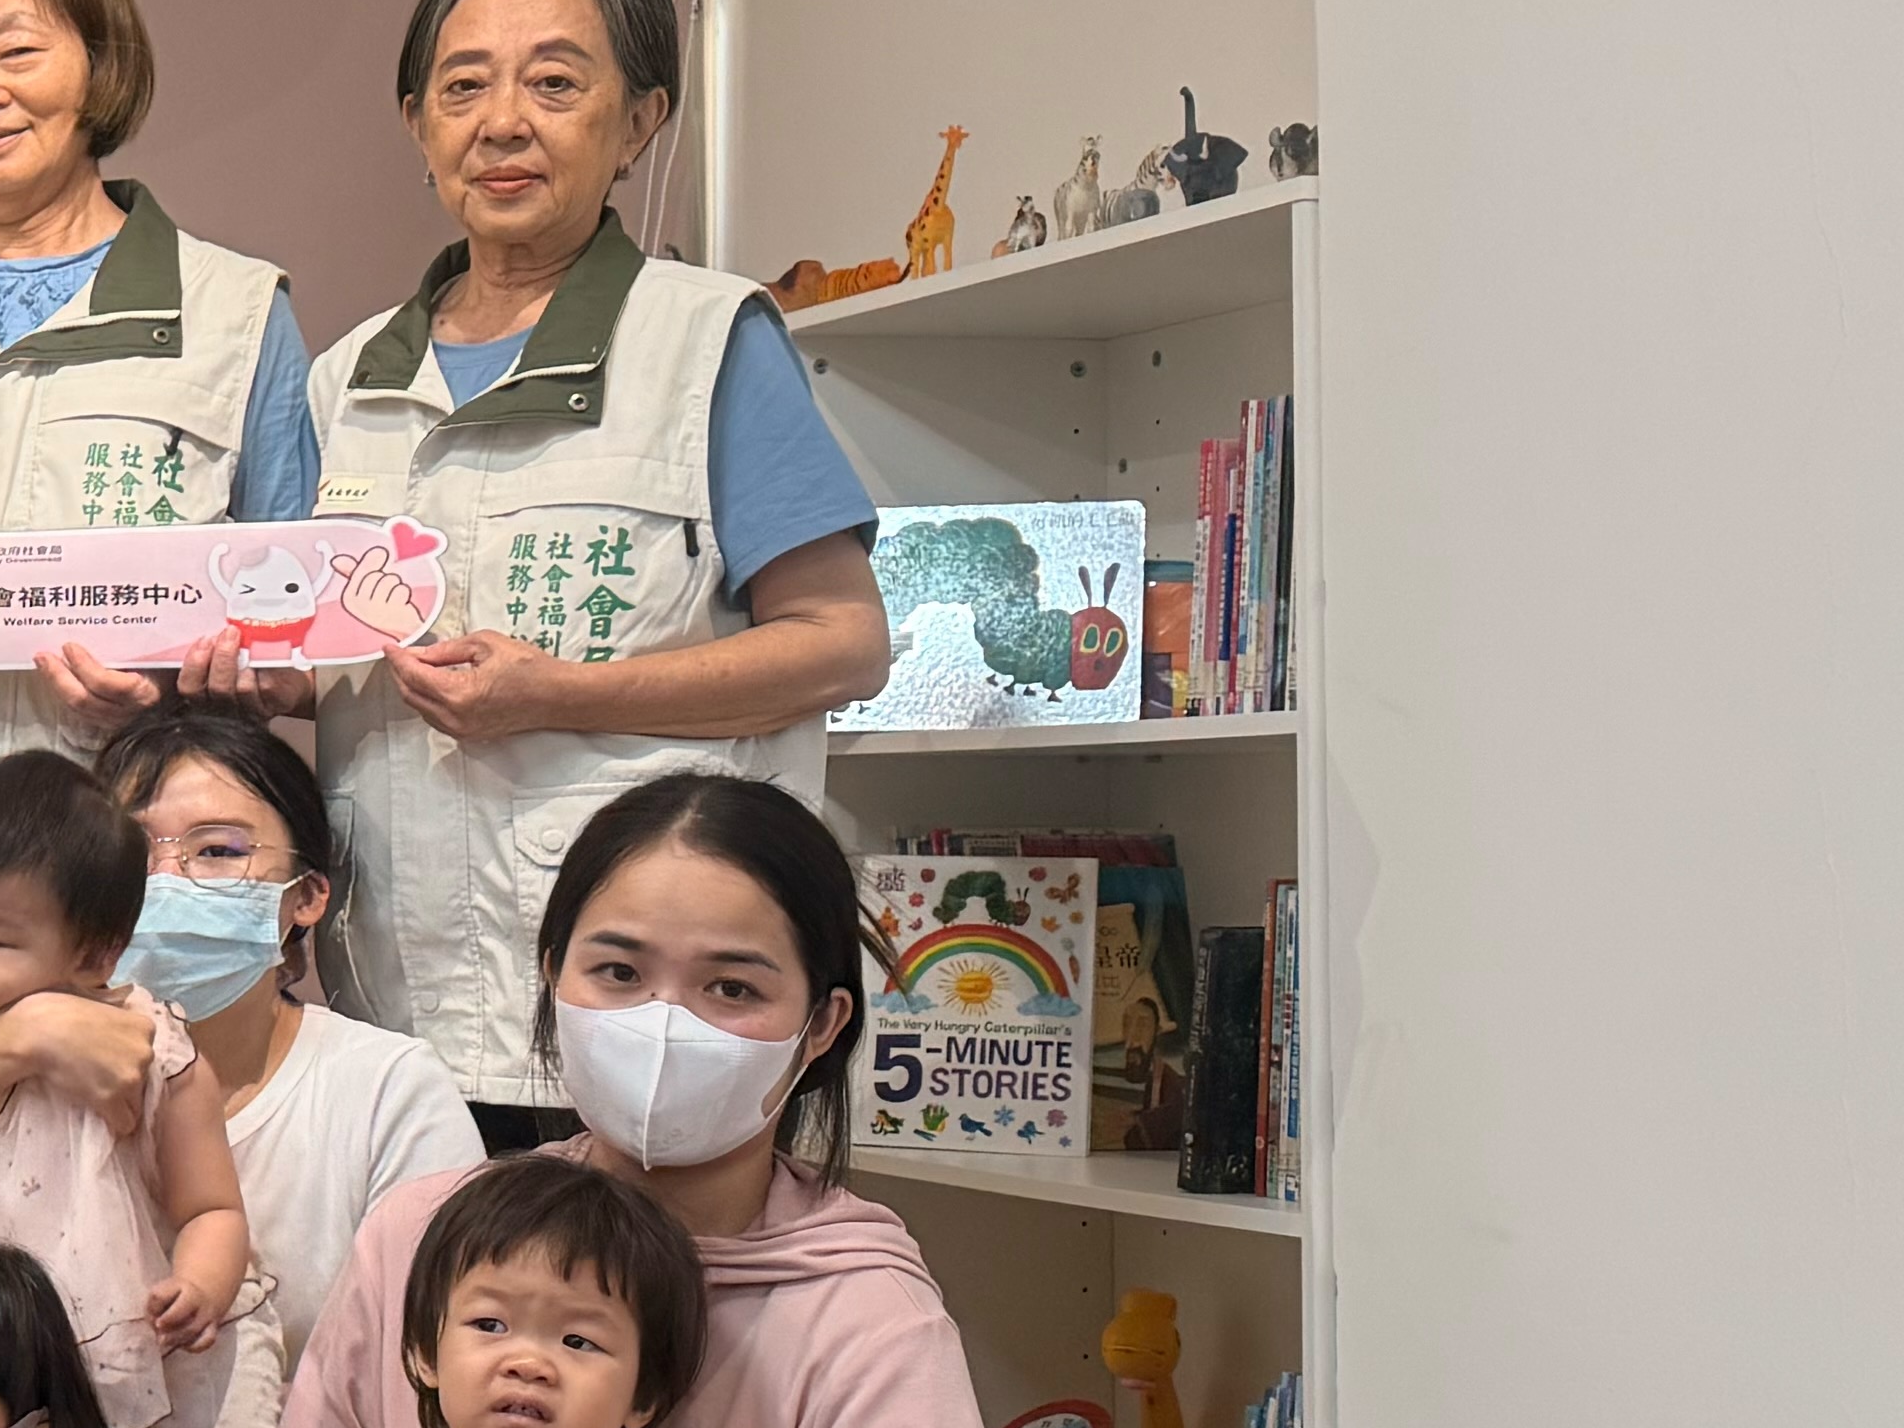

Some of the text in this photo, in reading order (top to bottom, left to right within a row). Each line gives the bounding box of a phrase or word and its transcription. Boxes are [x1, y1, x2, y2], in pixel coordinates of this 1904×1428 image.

[112, 615, 158, 625] Center
[878, 1018, 900, 1030] The
[935, 1020, 981, 1035] Hungry
[929, 1068, 1072, 1102] STORIES
